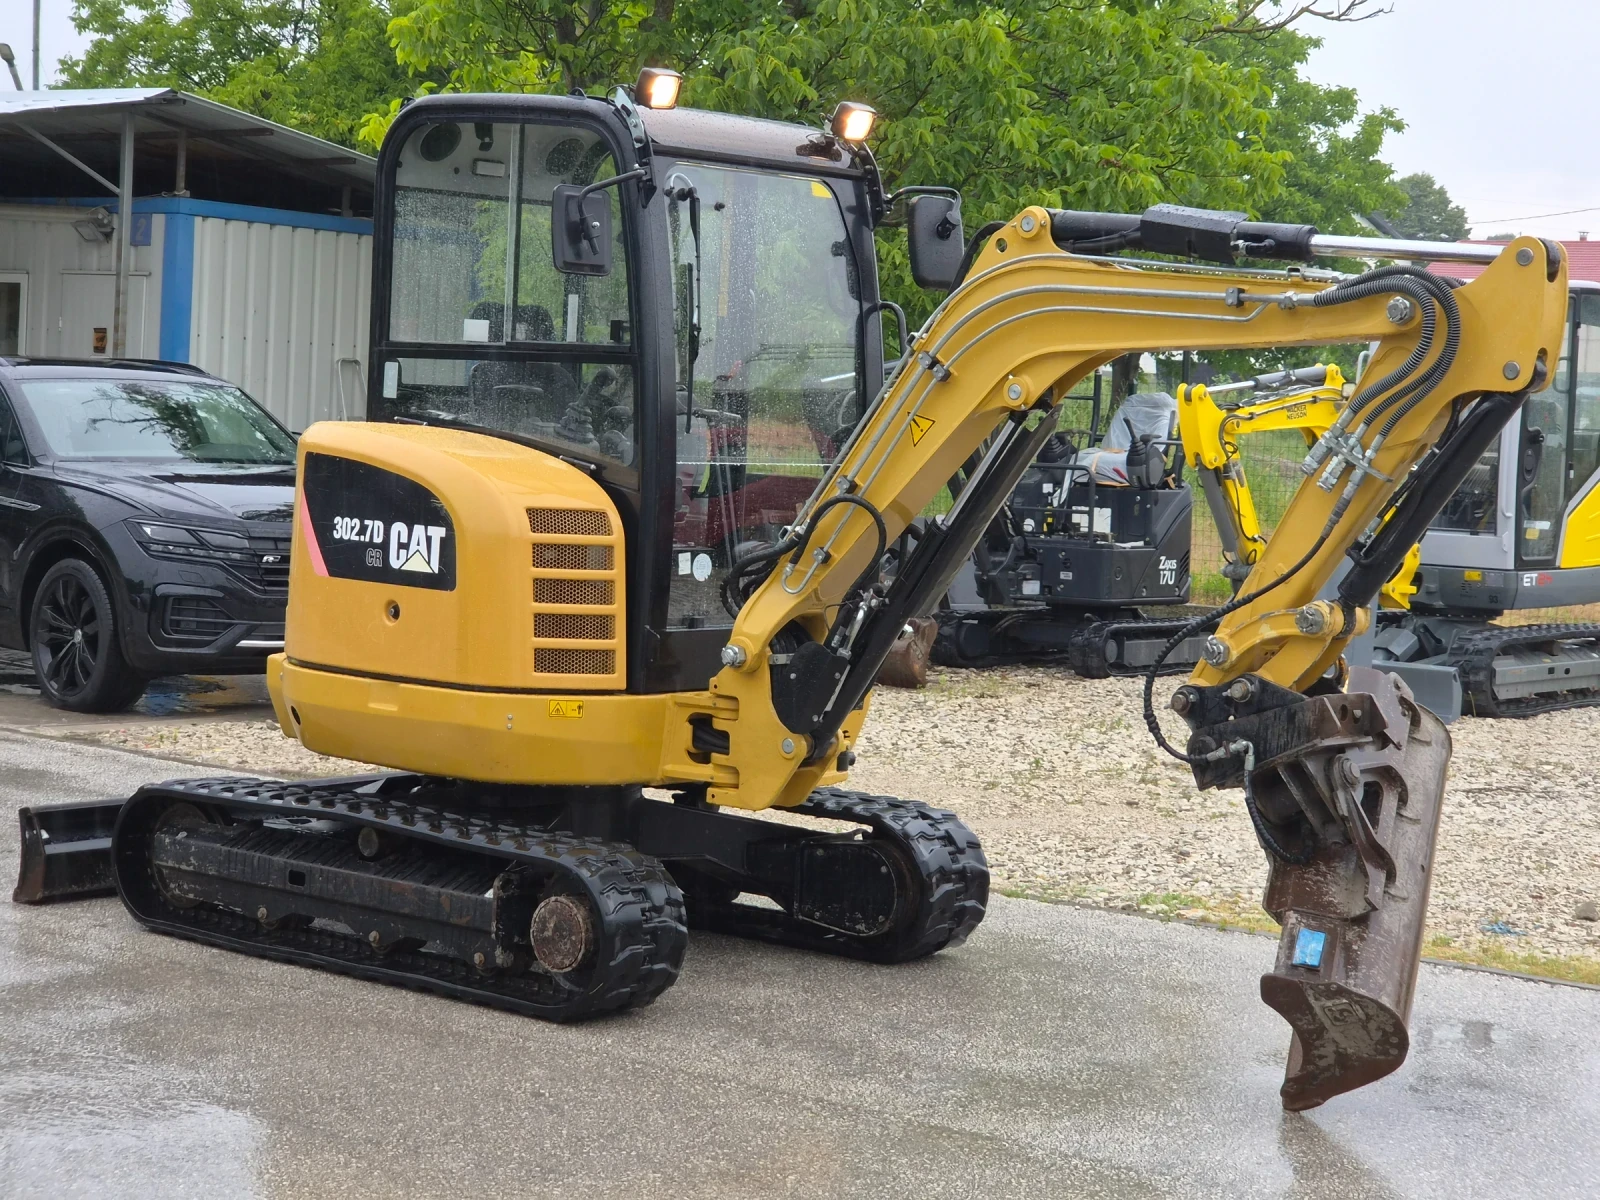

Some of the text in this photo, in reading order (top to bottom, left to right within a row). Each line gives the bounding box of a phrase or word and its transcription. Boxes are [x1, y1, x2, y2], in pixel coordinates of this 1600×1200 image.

[135, 217, 147, 241] 2
[1287, 411, 1307, 420] NEUSON
[333, 516, 384, 543] 302.7D
[366, 548, 382, 567] CR
[389, 522, 446, 574] CAT
[1160, 571, 1175, 585] 17U
